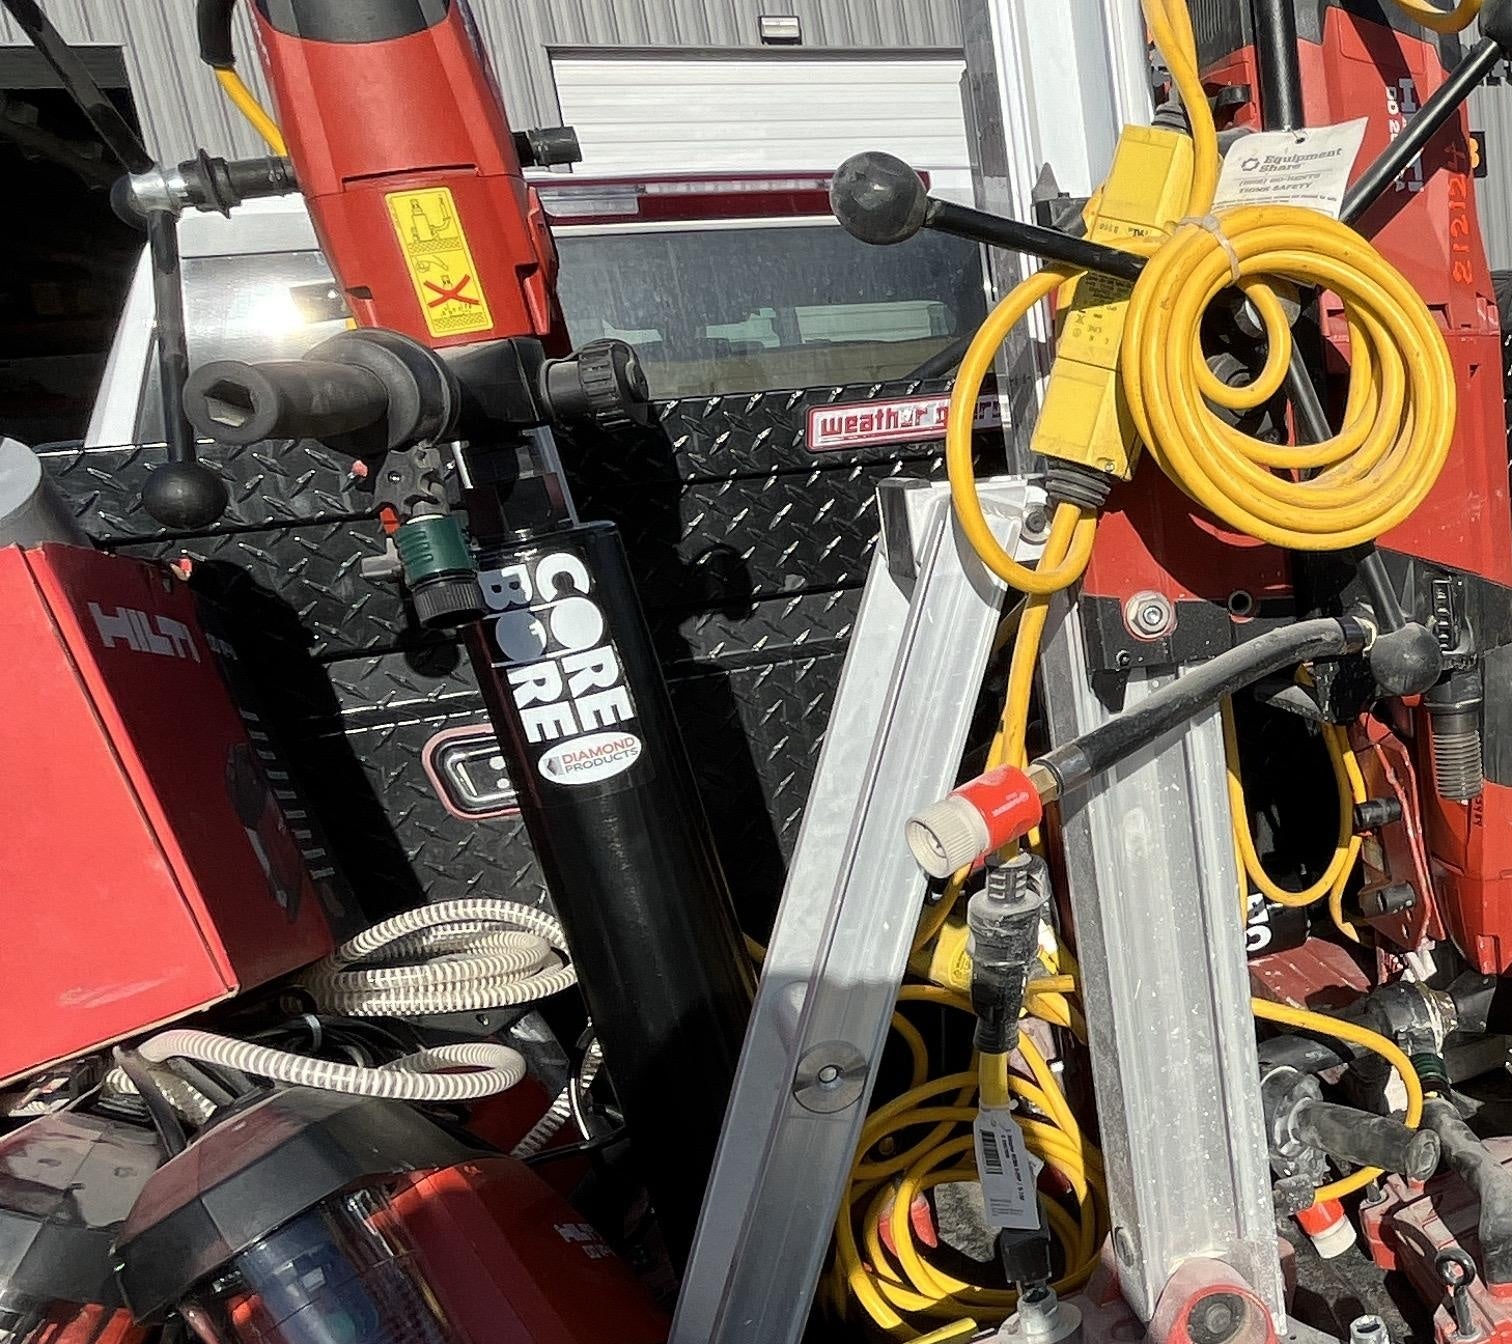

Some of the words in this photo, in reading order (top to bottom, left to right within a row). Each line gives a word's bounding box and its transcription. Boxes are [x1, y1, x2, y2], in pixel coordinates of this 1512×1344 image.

[1258, 162, 1302, 173] Share
[1263, 147, 1343, 166] Equipment
[1272, 181, 1313, 193] SAFETY
[87, 602, 201, 664] HILTI
[535, 552, 636, 733] CORE
[477, 563, 580, 745] BORE
[561, 735, 636, 765] DIAMOND
[563, 746, 640, 775] PRODUCTS
